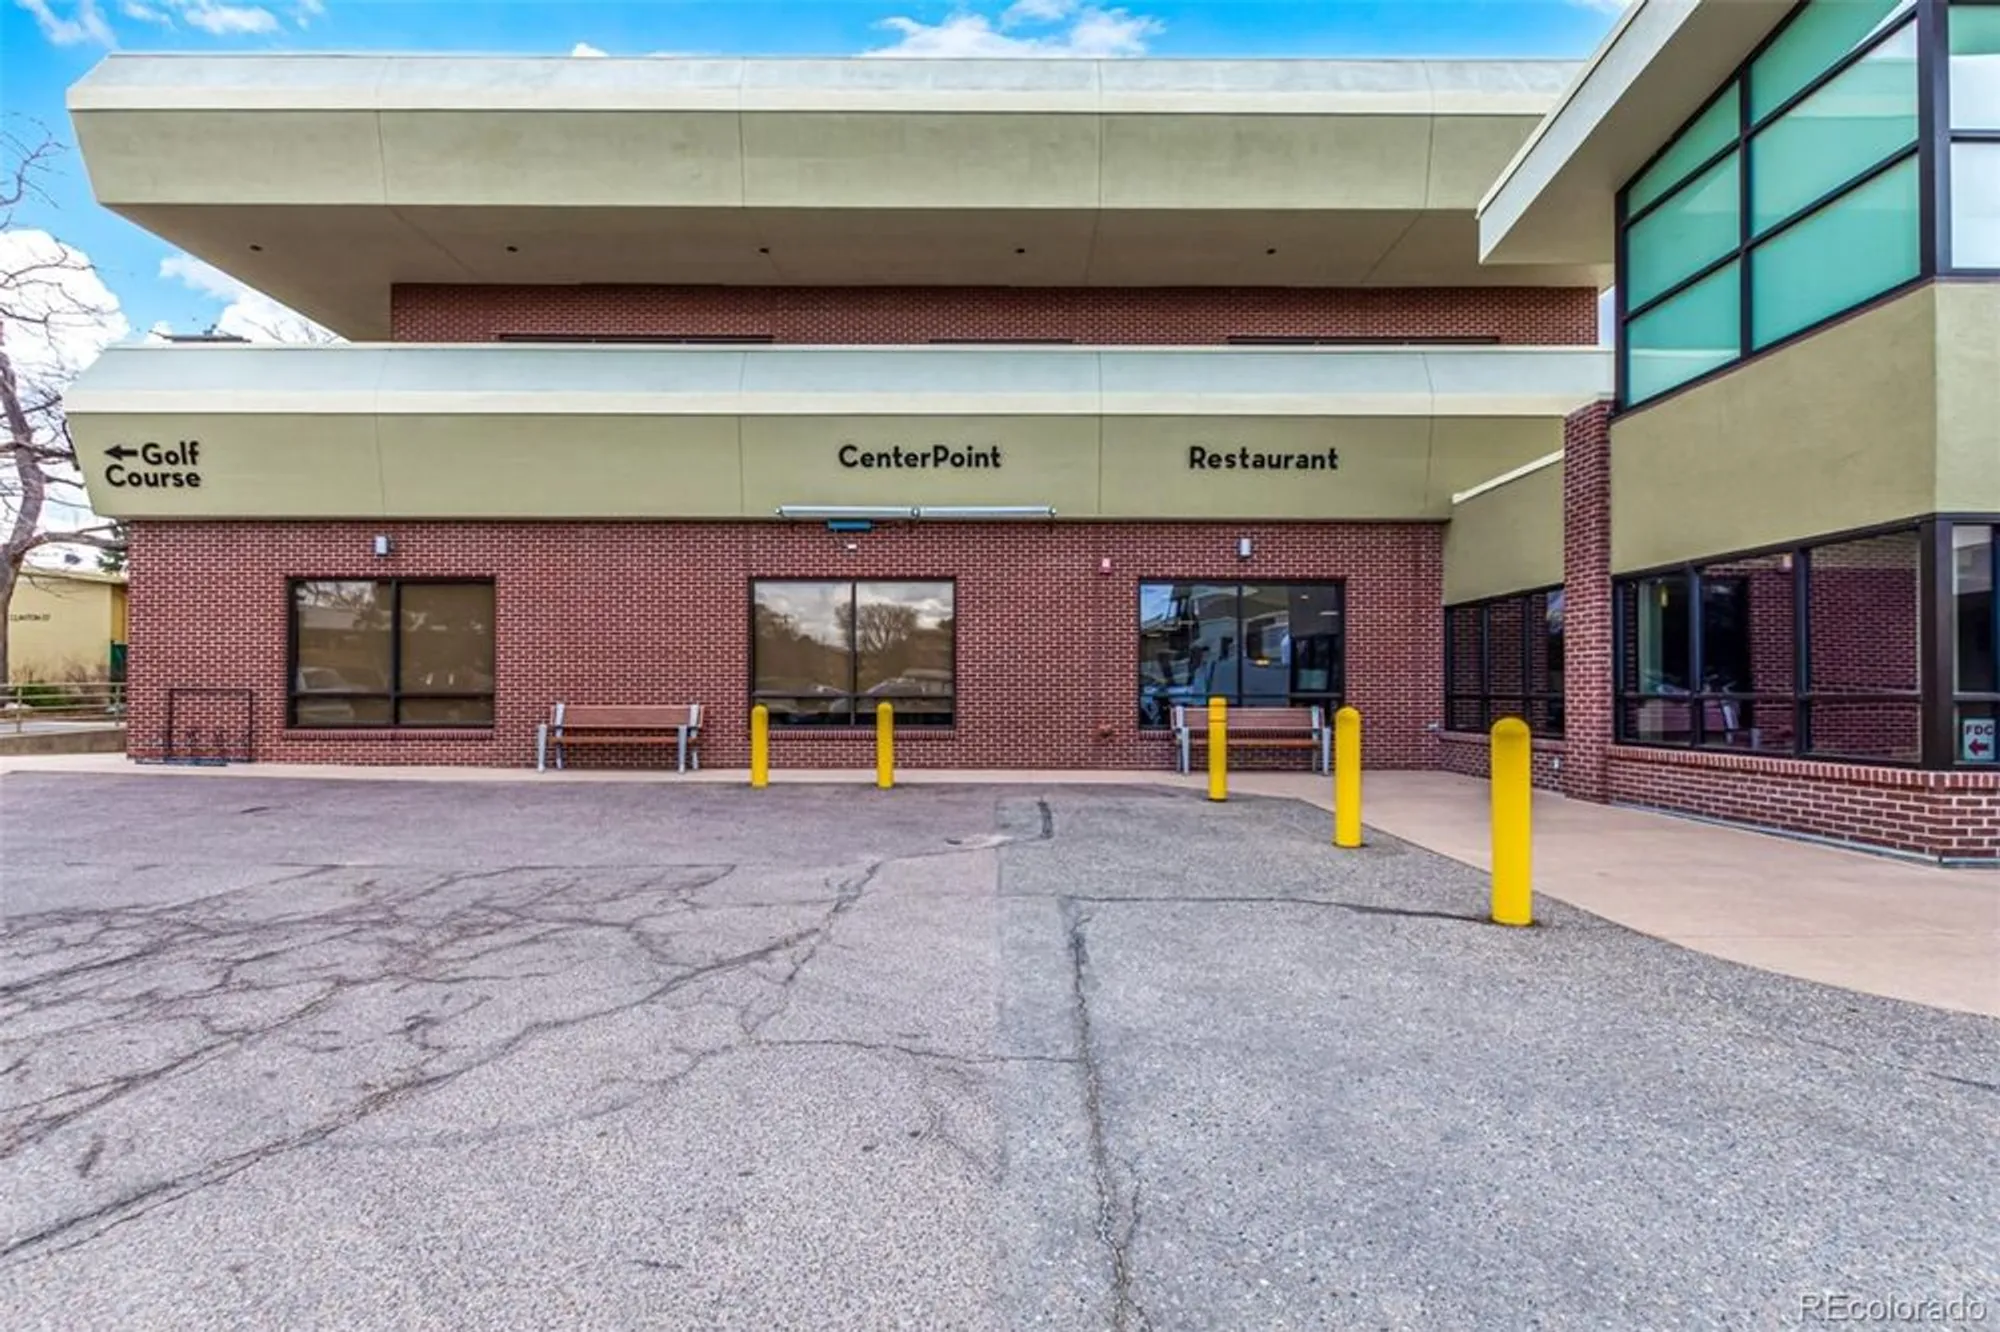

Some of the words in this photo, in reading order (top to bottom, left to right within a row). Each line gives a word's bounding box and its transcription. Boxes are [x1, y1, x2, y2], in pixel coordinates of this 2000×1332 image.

[142, 441, 199, 466] Golf
[838, 444, 1002, 468] CenterPoint
[1189, 445, 1339, 470] Restaurant
[105, 464, 202, 487] Course
[1965, 724, 1994, 736] FDC
